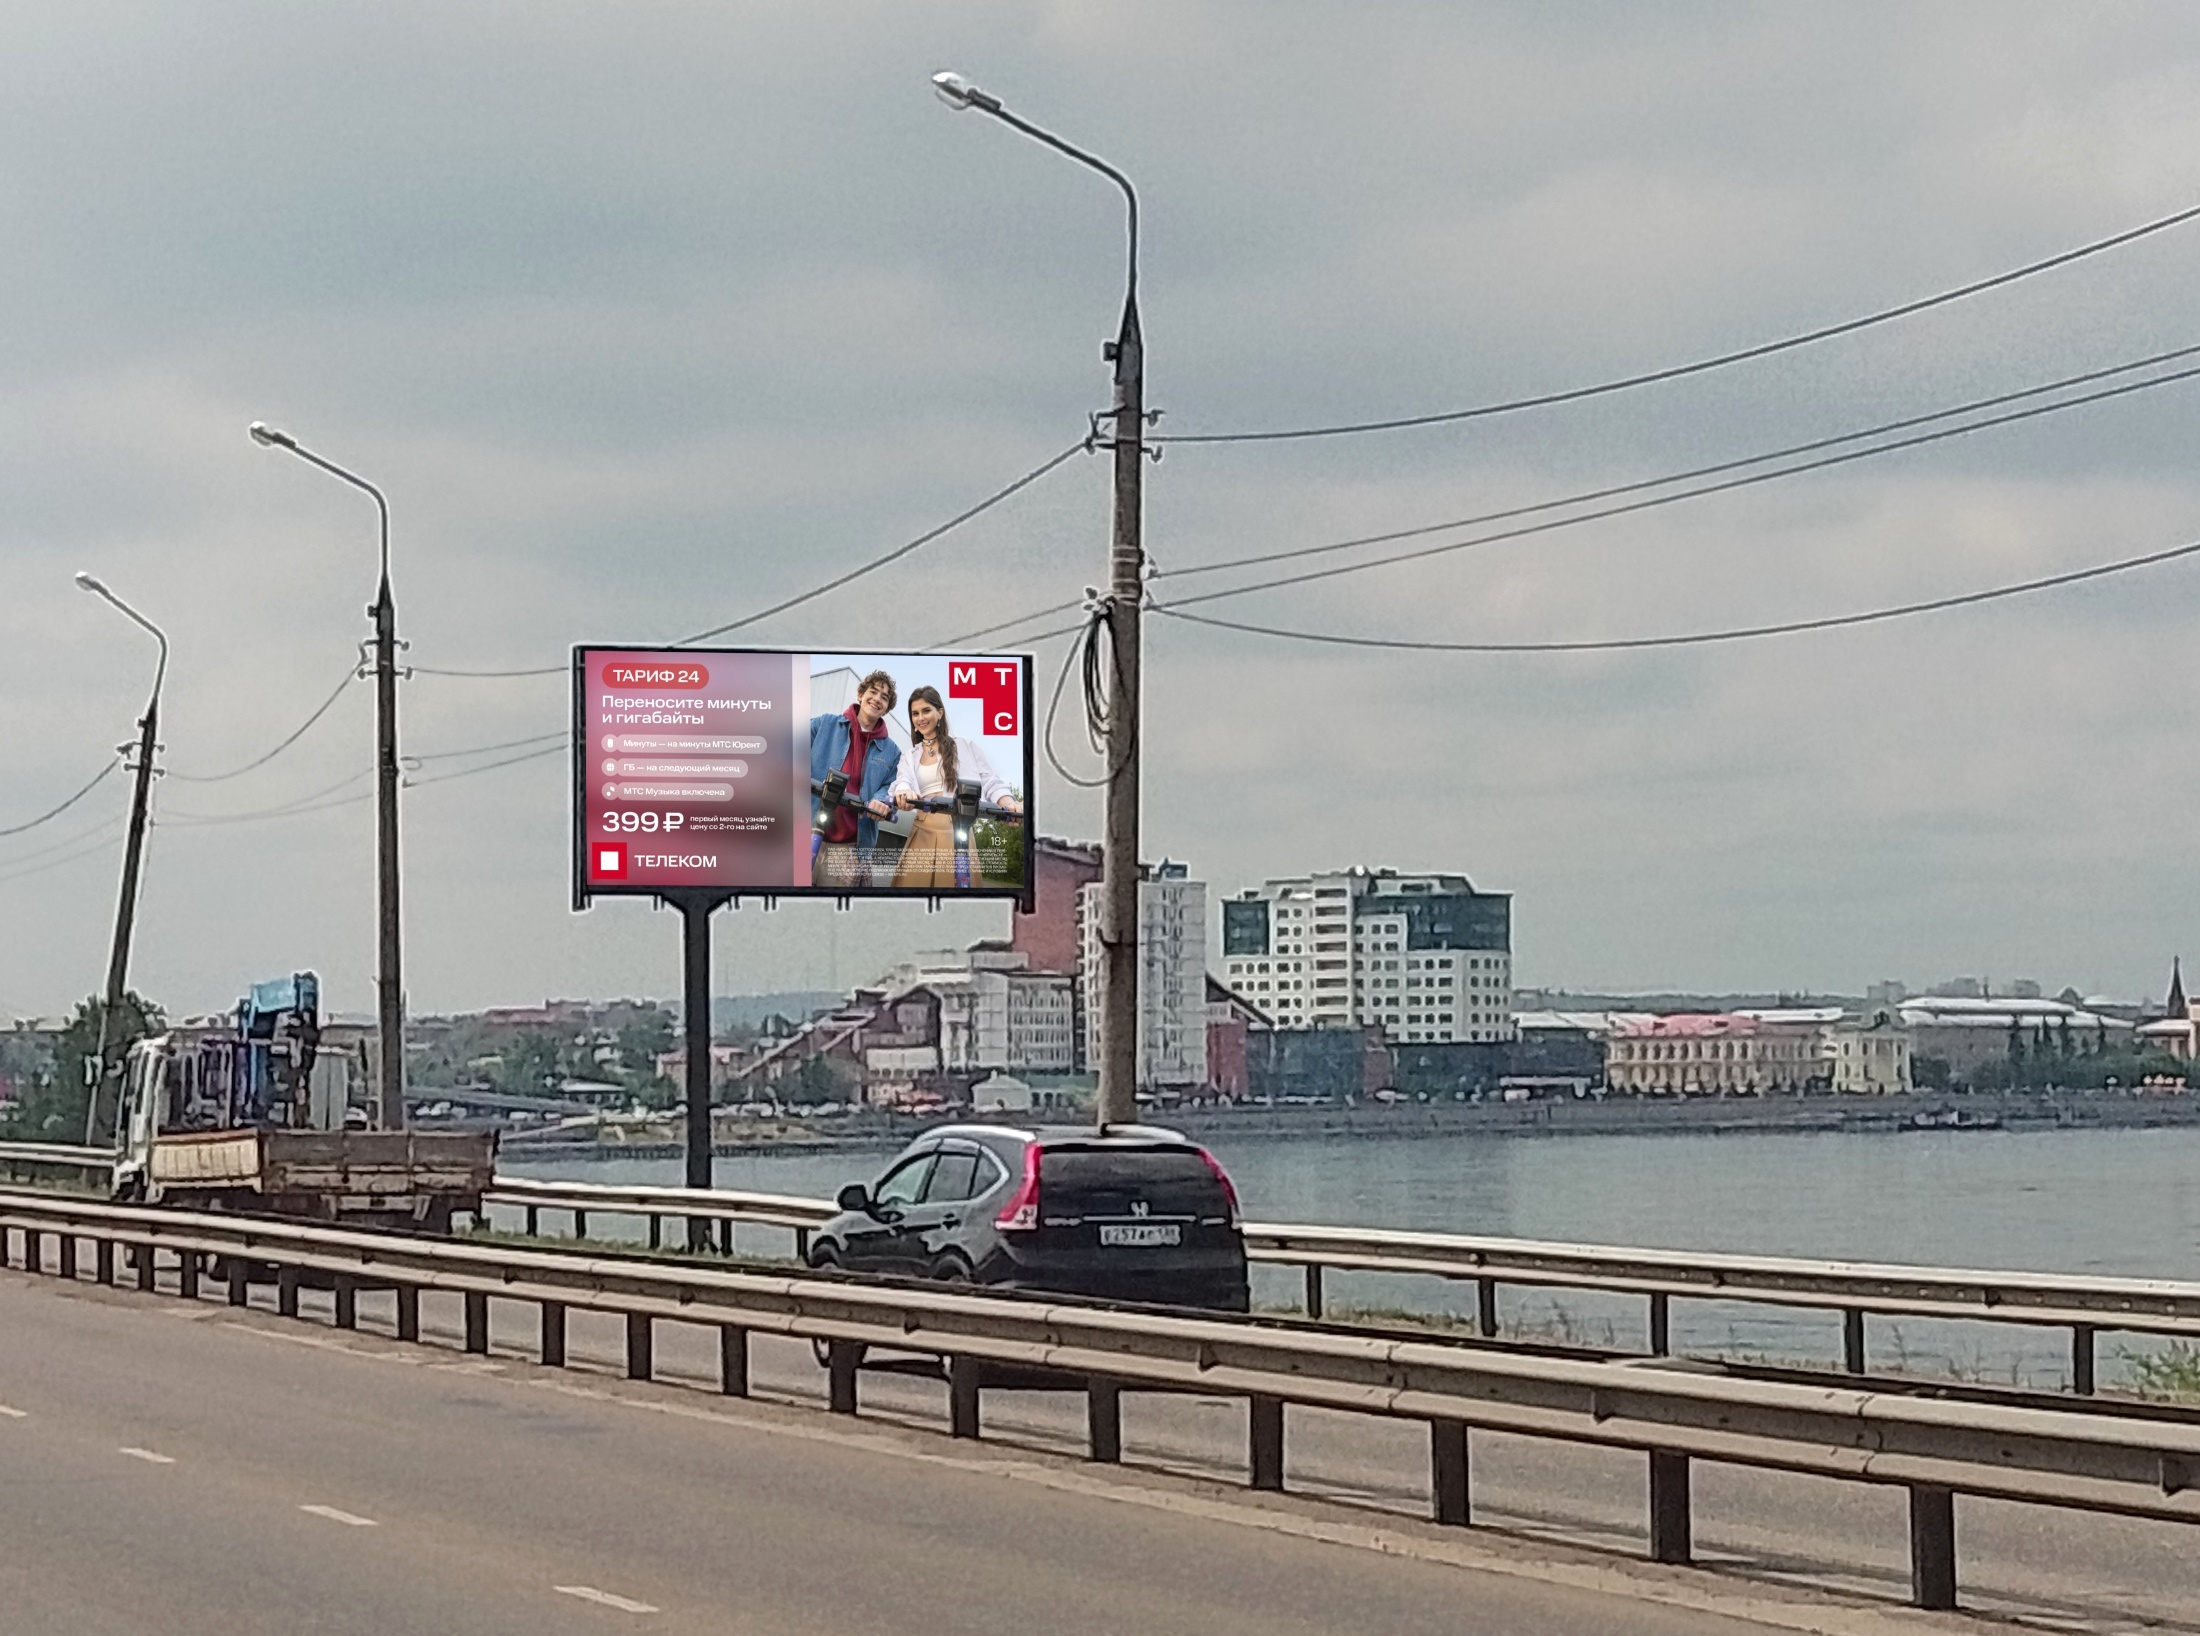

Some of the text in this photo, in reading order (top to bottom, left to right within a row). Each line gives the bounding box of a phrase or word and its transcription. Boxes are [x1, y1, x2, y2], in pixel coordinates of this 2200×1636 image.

[613, 669, 700, 683] ТАРИФ 24
[602, 695, 772, 713] Переносите минуты
[602, 711, 704, 725] и гигабайты
[623, 739, 657, 749] Минуты
[678, 741, 711, 750] минуты
[712, 741, 731, 749] МТС
[732, 741, 761, 750] Юрент
[658, 765, 711, 774] следующий
[712, 766, 741, 774] месяц
[623, 787, 644, 795] МТС
[645, 788, 680, 796] Музыка
[690, 815, 719, 823] первый
[745, 816, 775, 824] узнайте
[746, 823, 768, 831] сайте
[990, 836, 1008, 846] 18+
[634, 854, 717, 868] ТЕЛЕКОМ
